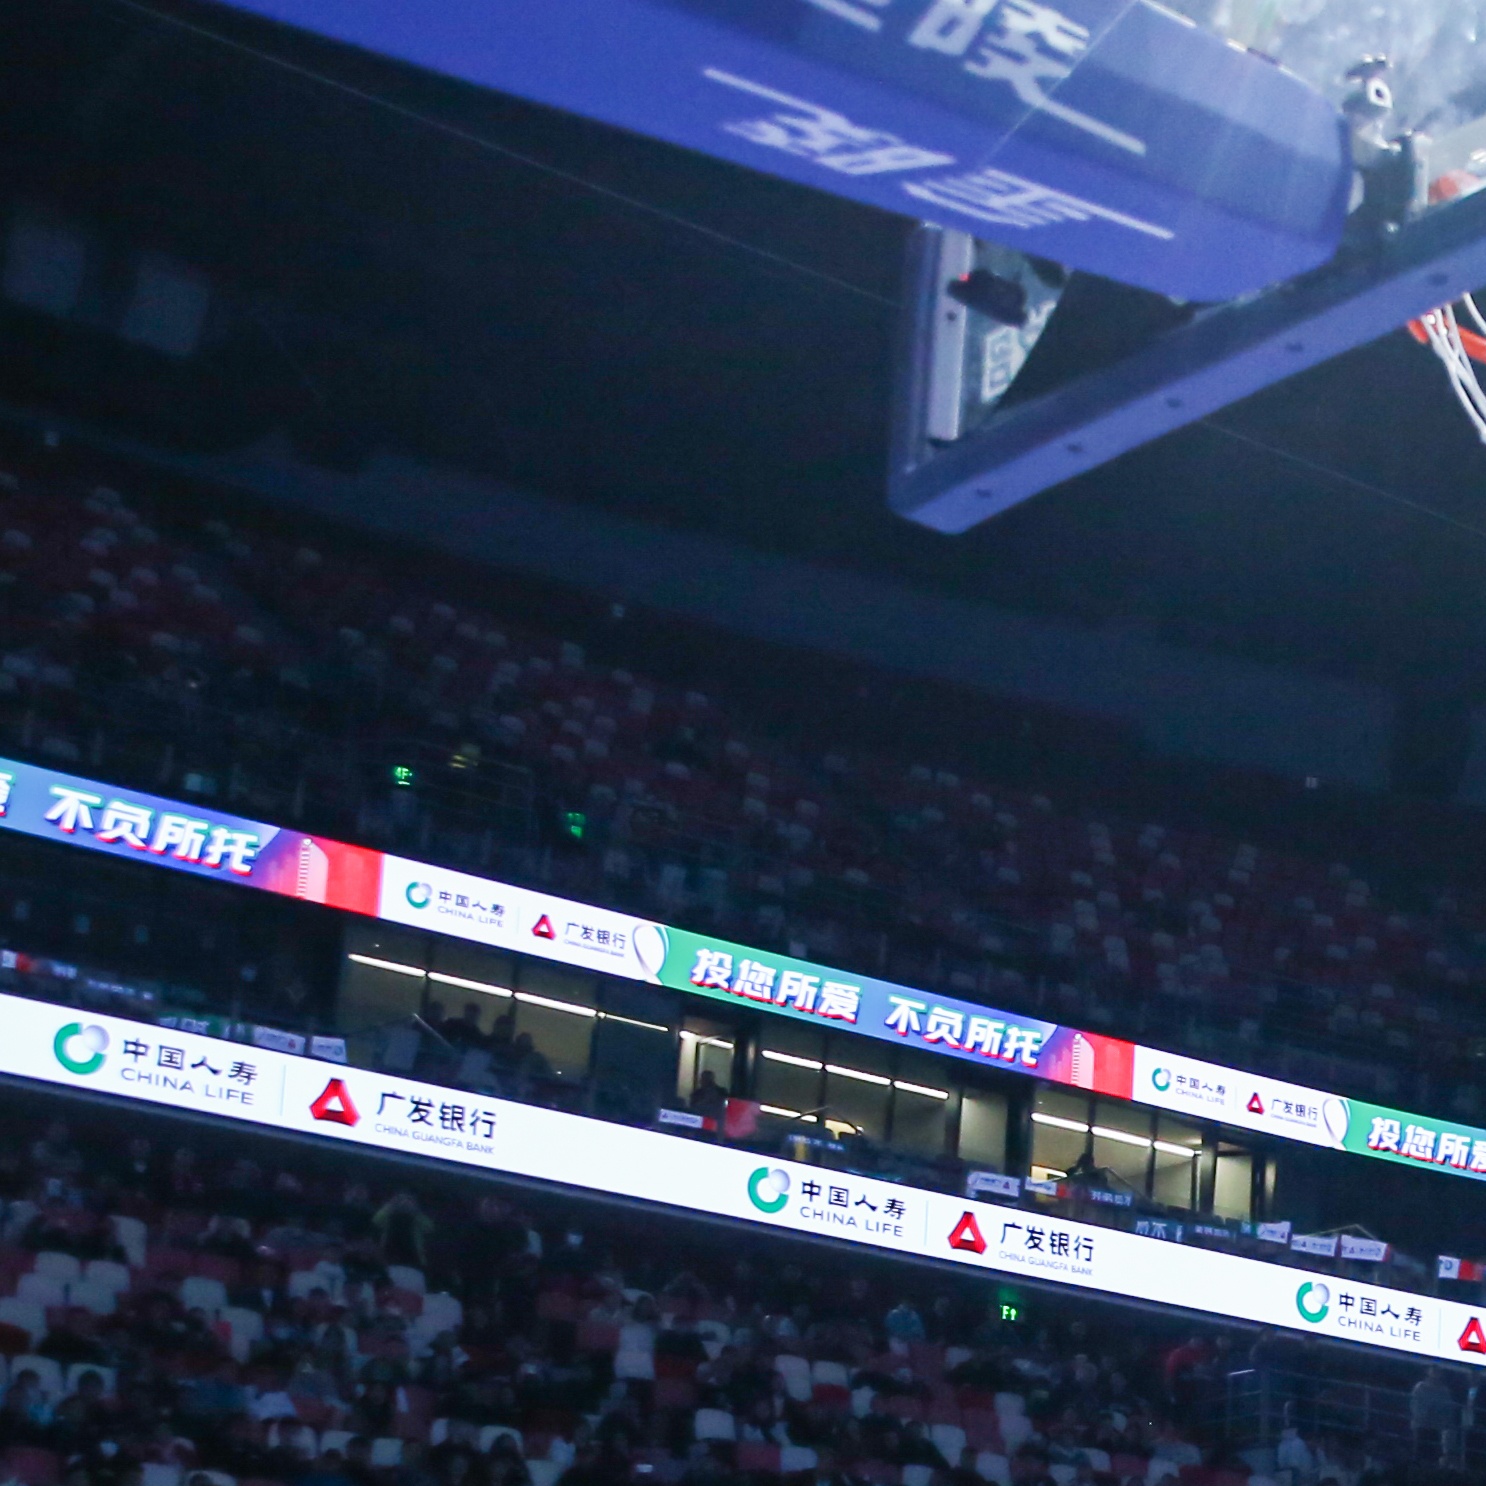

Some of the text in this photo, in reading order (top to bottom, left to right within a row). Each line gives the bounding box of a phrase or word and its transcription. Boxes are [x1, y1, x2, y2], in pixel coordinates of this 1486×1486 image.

[45, 784, 261, 877] 不负所托
[437, 905, 476, 921] CHINA
[438, 890, 507, 917] 中国人寿
[564, 922, 627, 950] 广发银行
[690, 948, 1044, 1067] 投您所爱 不负所托
[122, 1037, 259, 1087] 中国人寿
[120, 1067, 256, 1107] CHINA LIFE
[1176, 1073, 1226, 1096] 中国人寿
[375, 1091, 497, 1141] 广发银行
[1271, 1098, 1318, 1121] 广发银行
[374, 1122, 496, 1155] CHINA GUANGFA BANK
[800, 1178, 908, 1221] 中国人寿
[800, 1205, 905, 1238] CHINA LIFE
[1000, 1220, 1094, 1263] 广发银行
[998, 1249, 1093, 1277] CHINA GUANGFA BANK
[1339, 1291, 1423, 1328] 中国人寿
[1338, 1315, 1422, 1343] CHINA LIFE
